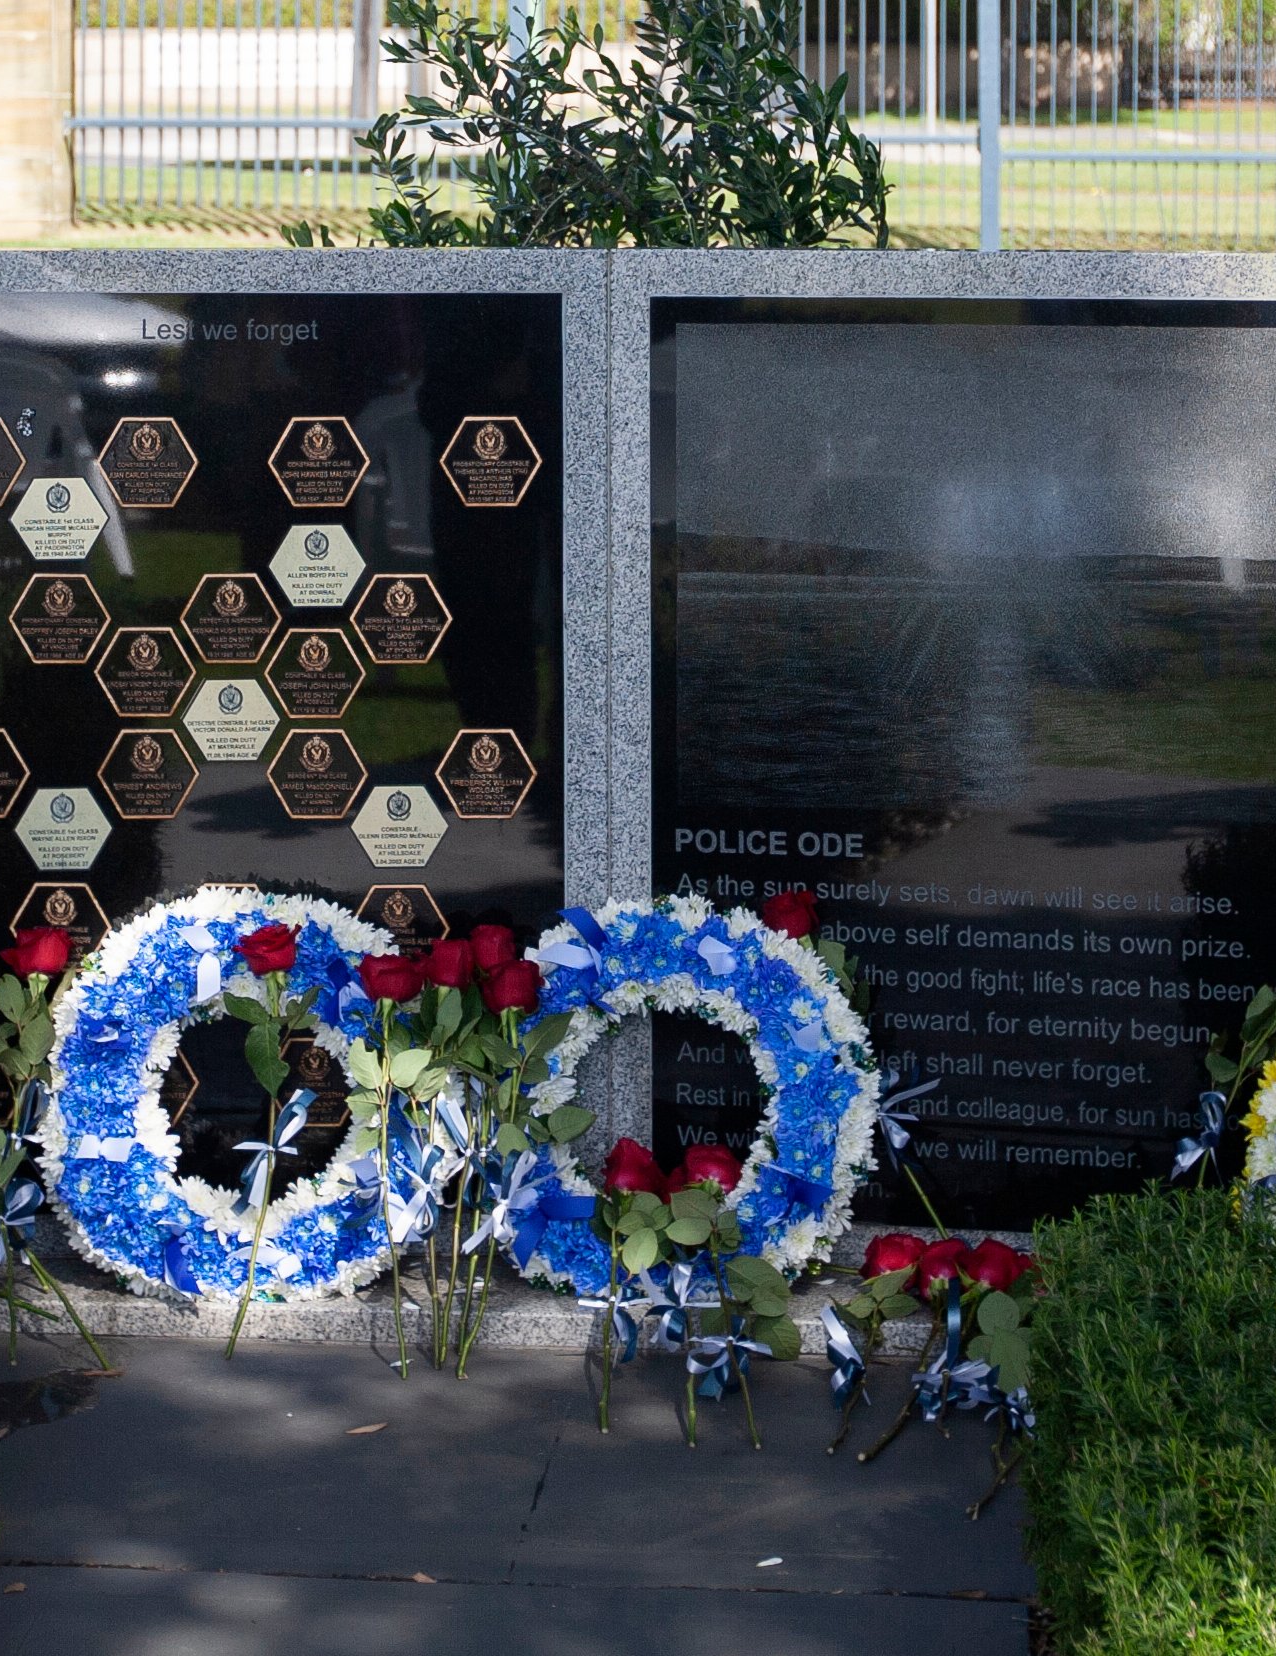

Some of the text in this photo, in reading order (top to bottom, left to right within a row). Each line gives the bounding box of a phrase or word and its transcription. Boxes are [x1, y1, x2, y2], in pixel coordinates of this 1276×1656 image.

[142, 318, 319, 346] Lest we forget
[675, 828, 864, 857] POLICE ODE
[677, 873, 708, 895] As
[717, 873, 755, 896] the
[817, 879, 891, 906] surely
[900, 883, 958, 907] sets,
[967, 883, 1034, 908] dawn
[1044, 886, 1084, 909] will
[1092, 891, 1138, 911] see
[1148, 890, 1162, 911] it
[1170, 891, 1240, 915] arise.
[820, 921, 1251, 960] above self demands its own prize.
[864, 964, 898, 986] the
[906, 968, 962, 995] good
[970, 967, 1025, 996] fight;
[1033, 970, 1084, 993] life's
[1092, 977, 1141, 997] race
[1150, 976, 1191, 999] has
[1199, 978, 1256, 1002] been
[884, 1010, 977, 1034] reward,
[987, 1012, 1020, 1034] for
[1028, 1015, 1122, 1045] eternity
[677, 1042, 724, 1064] And
[880, 1051, 918, 1073] left
[926, 1052, 983, 1075] shall
[993, 1059, 1065, 1079] never
[1072, 1058, 1152, 1088] forget.
[676, 1083, 725, 1106] Rest
[733, 1085, 750, 1106] in
[908, 1095, 949, 1116] and
[957, 1097, 1071, 1127] colleague,
[1079, 1101, 1108, 1123] for
[1116, 1108, 1159, 1127] sun
[1164, 1107, 1203, 1129] has
[677, 1125, 717, 1147] We
[915, 1140, 951, 1159] we
[959, 1139, 997, 1161] will
[1005, 1144, 1142, 1169] remember.
